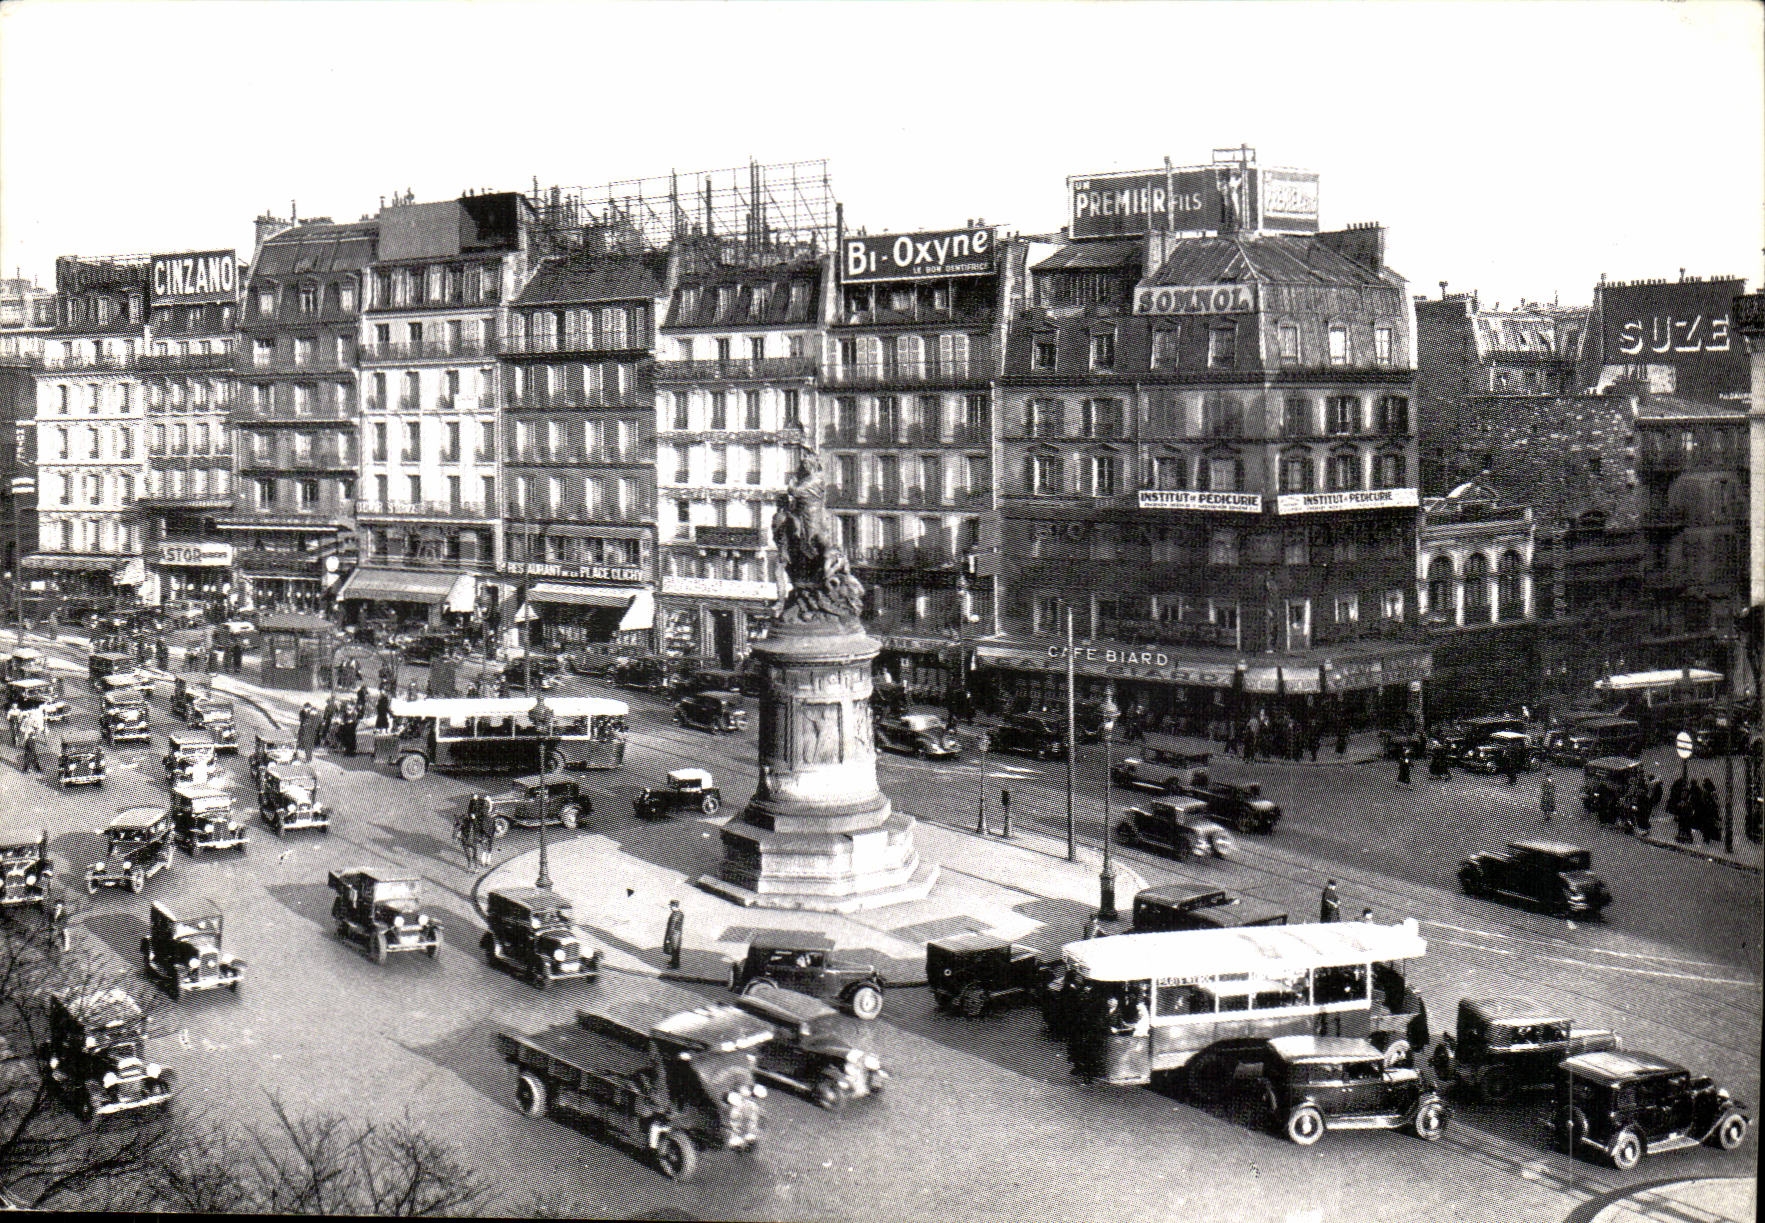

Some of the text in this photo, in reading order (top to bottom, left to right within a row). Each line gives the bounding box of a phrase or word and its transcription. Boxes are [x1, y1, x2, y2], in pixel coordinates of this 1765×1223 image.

[1076, 188, 1202, 218] PREMIER FILS
[154, 255, 233, 295] CINZANO
[1138, 287, 1250, 313] SOMNOL
[1620, 314, 1730, 354] SUZE
[1141, 492, 1190, 502] INSTITUT
[1198, 494, 1259, 506] PEDICURIE
[1303, 494, 1343, 505] INSTITUT
[507, 562, 562, 576] RESAURANT
[579, 565, 610, 580] PLACE
[1106, 649, 1168, 666] BIARD
